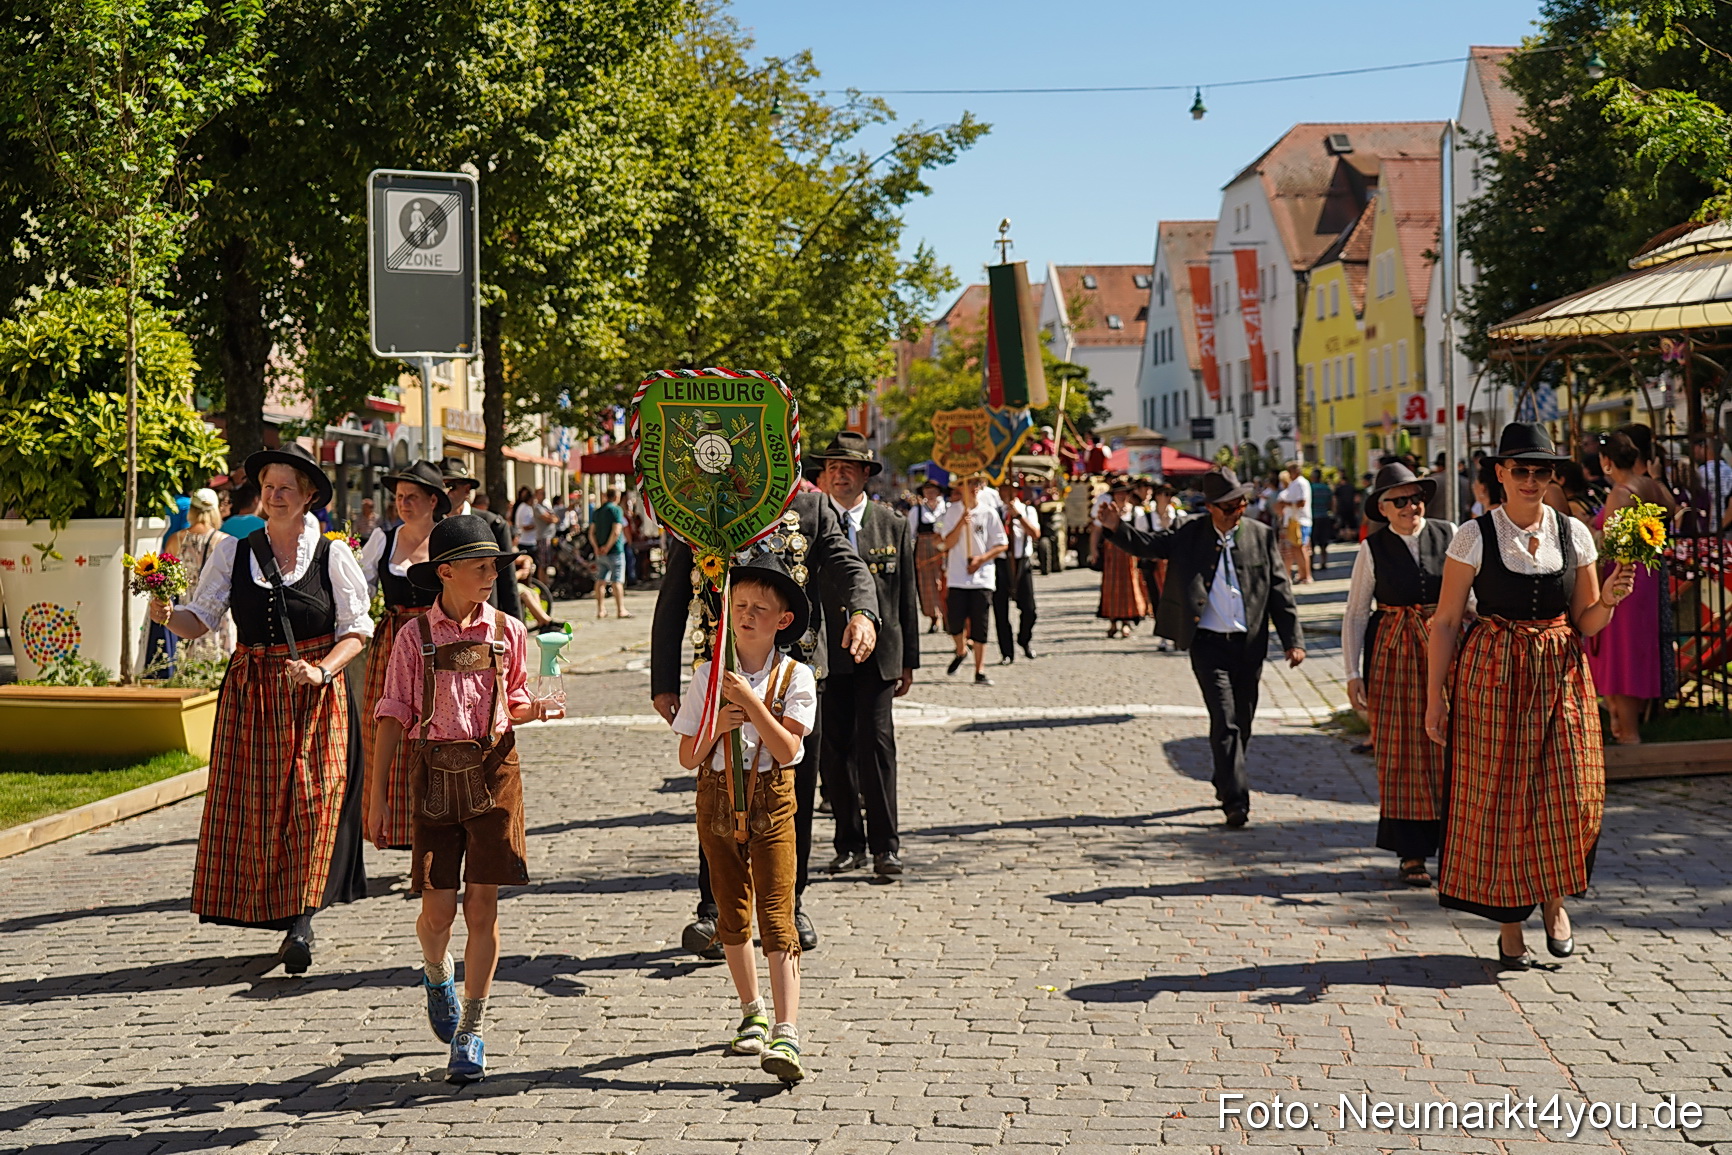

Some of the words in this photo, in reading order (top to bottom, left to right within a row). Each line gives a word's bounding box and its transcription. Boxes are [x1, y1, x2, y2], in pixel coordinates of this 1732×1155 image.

[405, 253, 443, 267] ZONE
[663, 382, 765, 401] LEINBURG
[644, 422, 764, 545] SCHUTZENGESELHAFT
